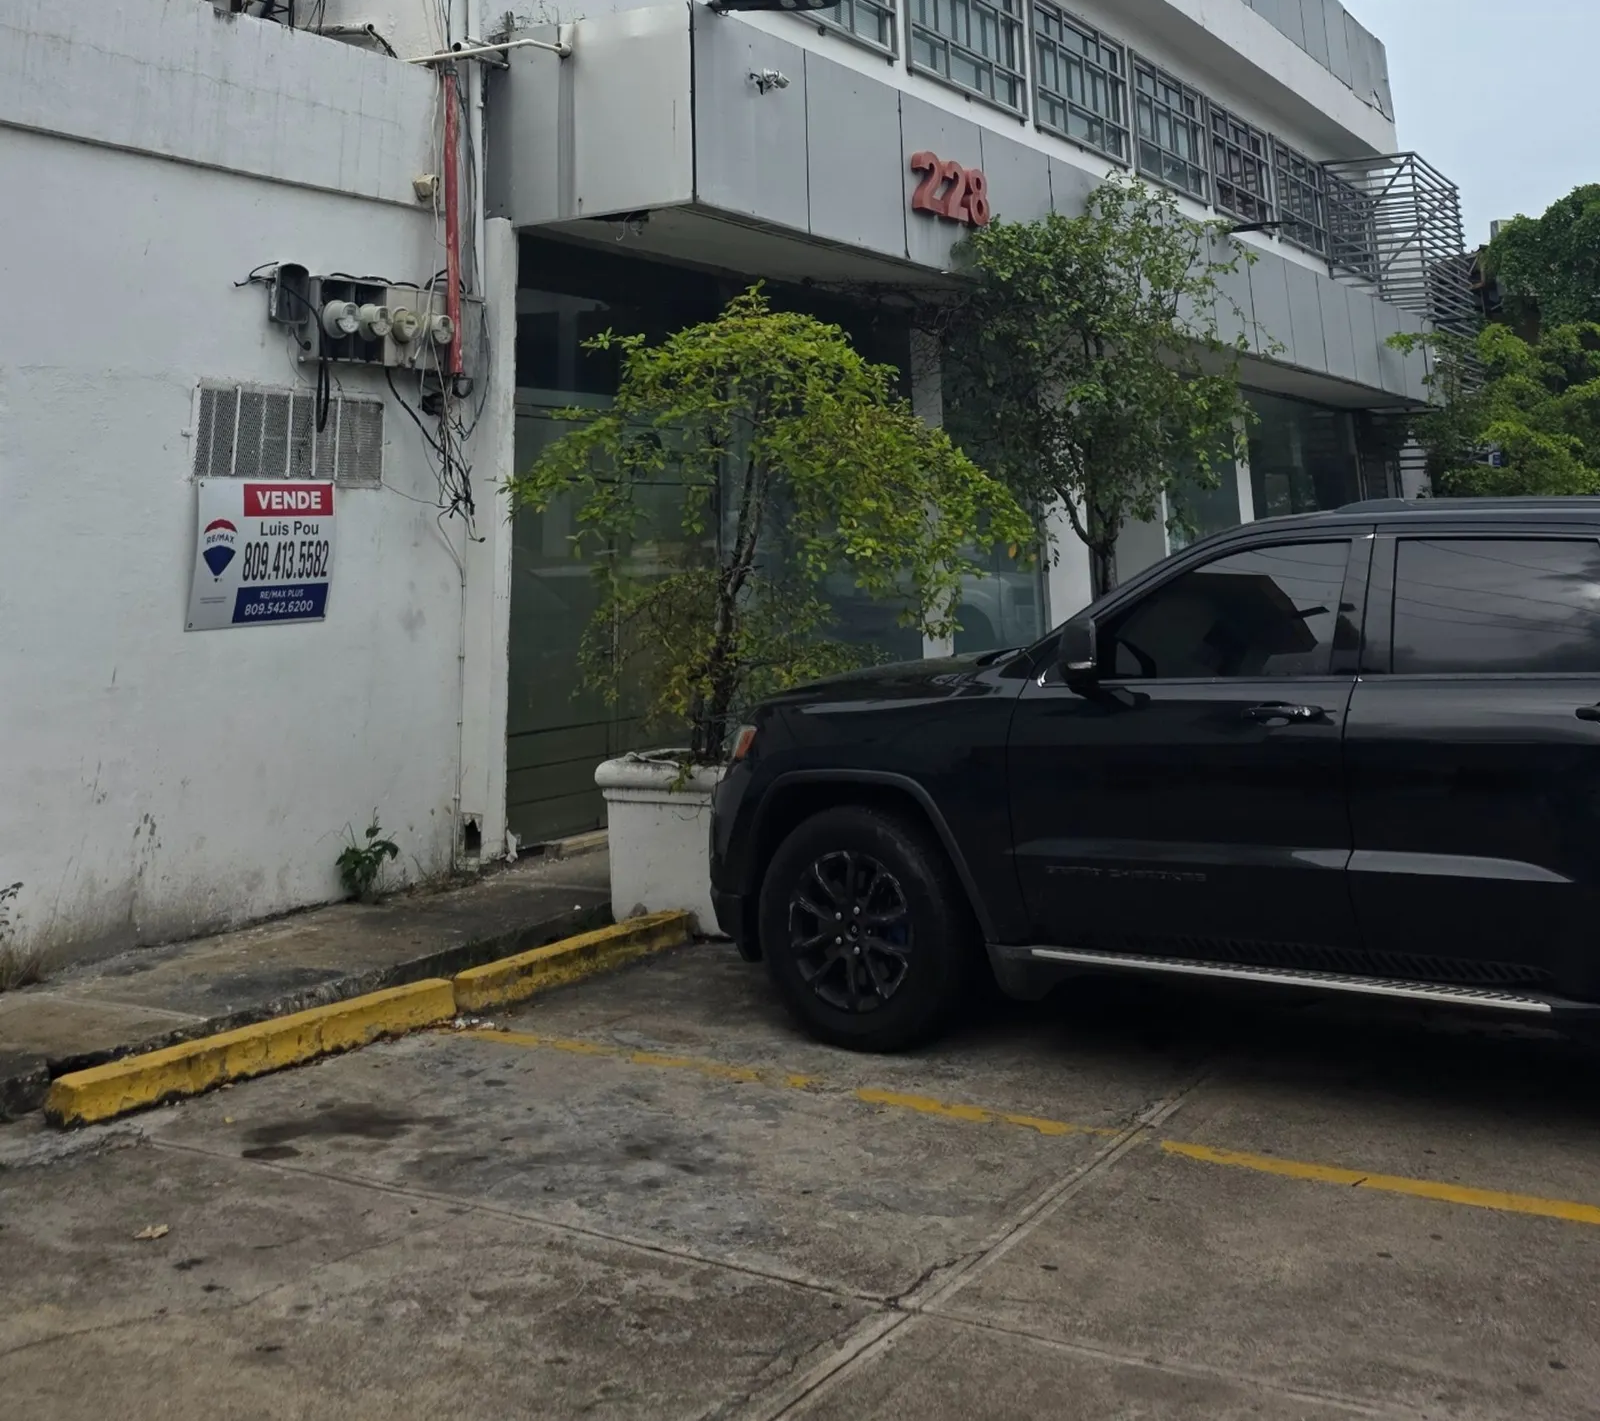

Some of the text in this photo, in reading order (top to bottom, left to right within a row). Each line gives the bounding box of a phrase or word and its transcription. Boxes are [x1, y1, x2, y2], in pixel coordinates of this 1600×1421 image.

[911, 151, 990, 227] 228
[256, 491, 322, 510] VENDE
[260, 520, 319, 536] Luis Pou
[206, 533, 235, 545] RE/MAX
[242, 540, 329, 581] 809.413.5582
[260, 588, 304, 600] RE/MAX PLUS
[244, 600, 313, 616] 809.542.6200
